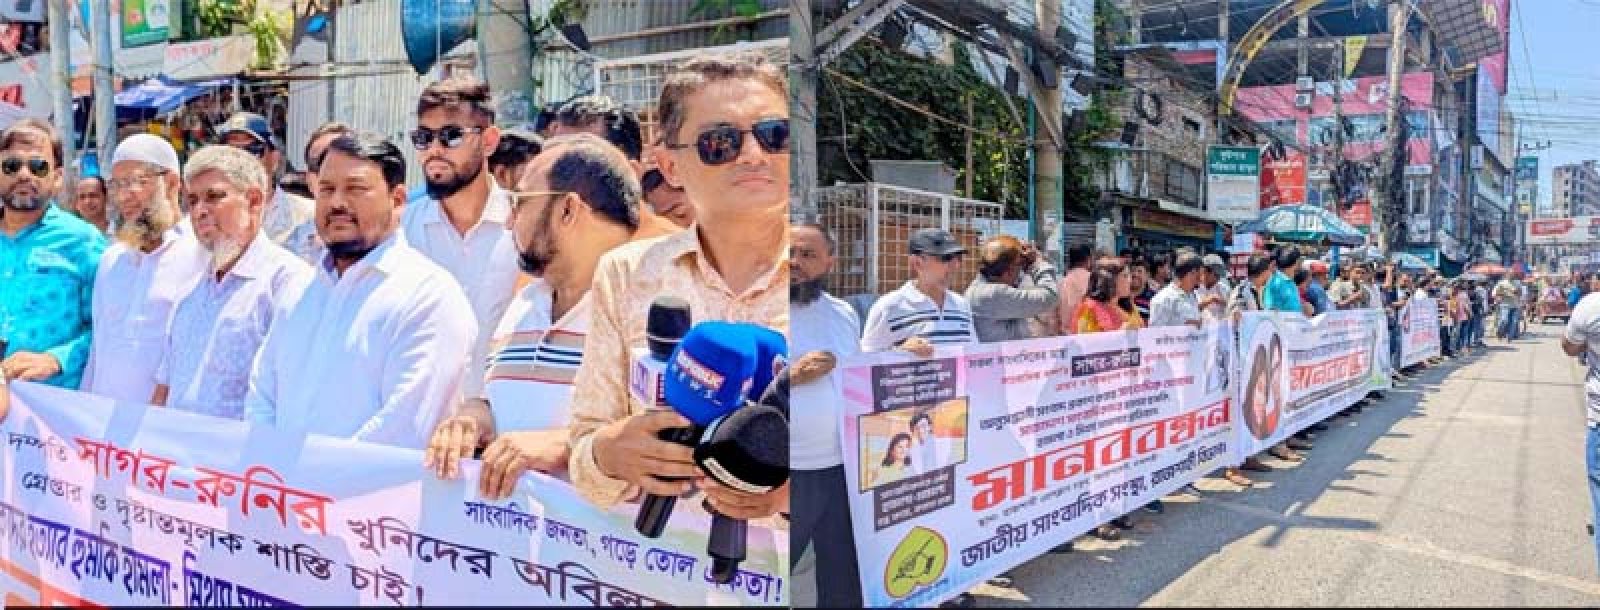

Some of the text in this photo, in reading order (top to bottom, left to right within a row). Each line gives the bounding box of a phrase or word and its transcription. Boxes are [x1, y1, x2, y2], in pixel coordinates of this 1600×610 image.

[966, 397, 1232, 512] মানববন্ধন
[71, 436, 336, 536] সাগর-রুনির
[348, 517, 497, 578] খুনিদের
[509, 555, 678, 606] অবিল
[93, 493, 107, 511] ও
[115, 497, 245, 554] দৃষ্টান্তমূলক
[253, 537, 335, 580] শাস্তি
[464, 500, 538, 536] সাংবাদিক
[544, 518, 598, 558] জনতা,
[601, 533, 639, 570] গড়ে
[645, 547, 698, 582] তোল
[1032, 491, 1108, 538] সাংবাদিক
